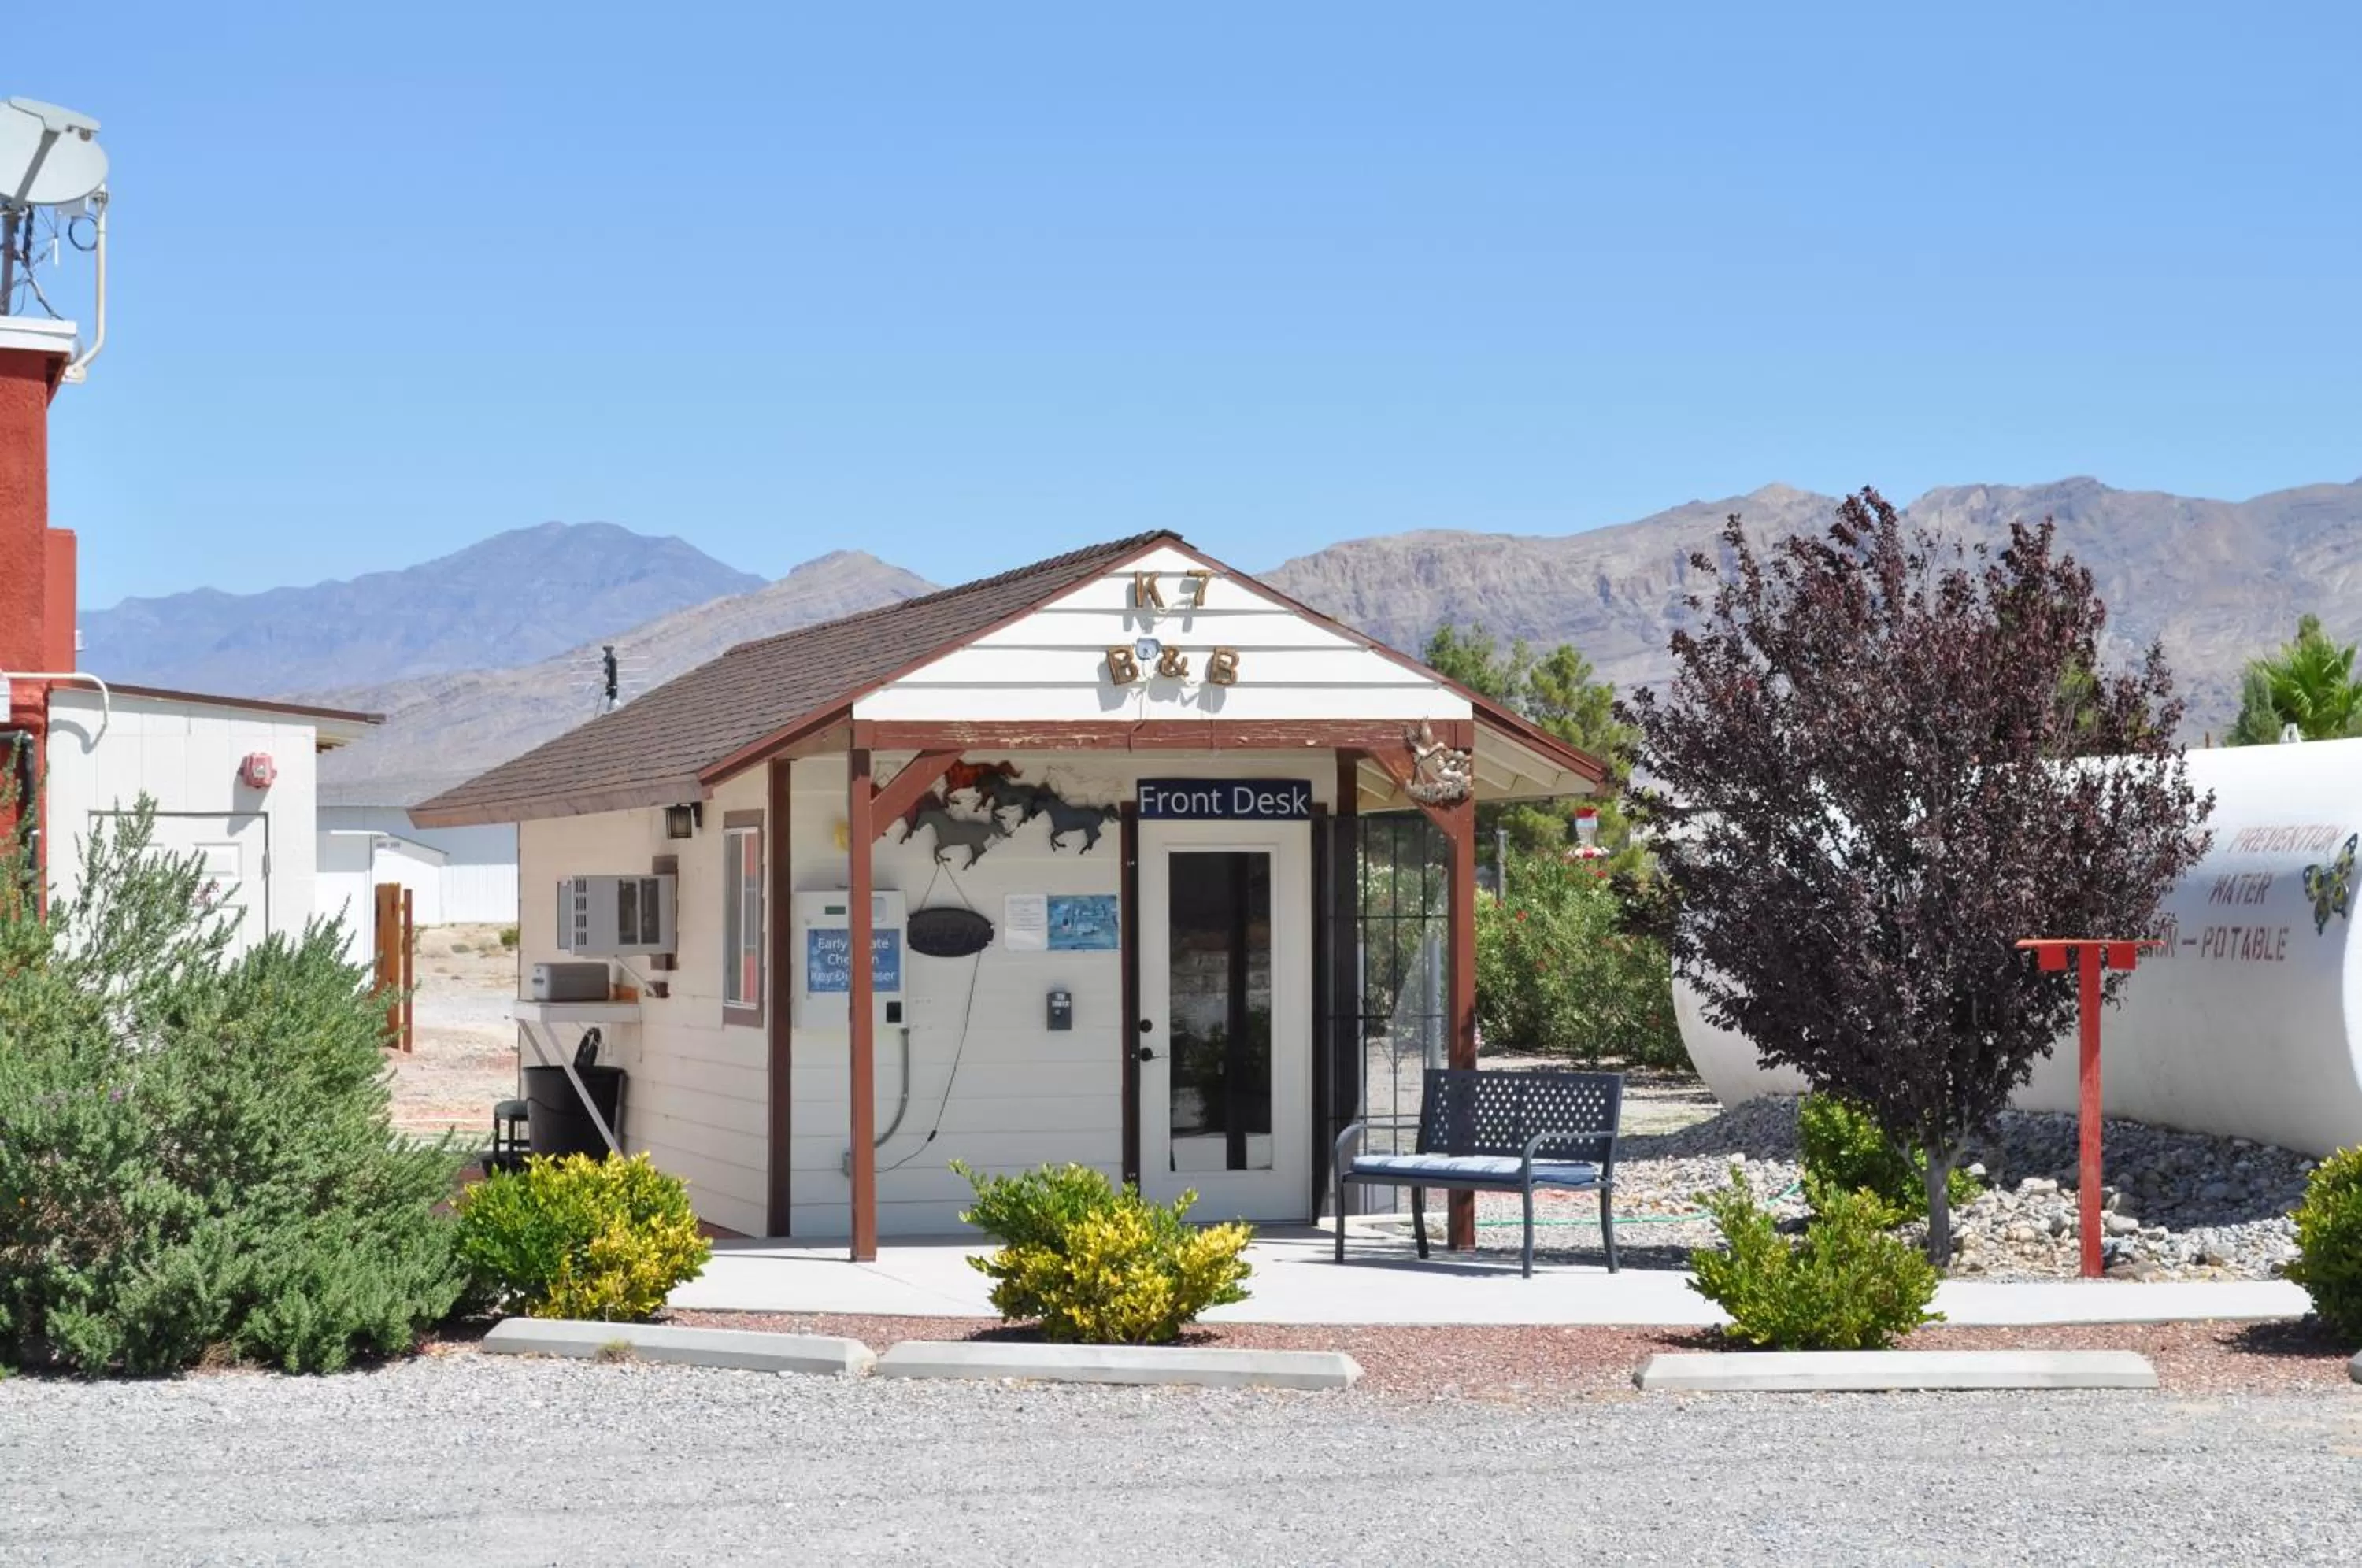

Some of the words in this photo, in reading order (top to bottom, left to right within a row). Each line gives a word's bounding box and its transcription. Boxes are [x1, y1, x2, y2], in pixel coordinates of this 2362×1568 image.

[1135, 571, 1164, 608] K
[1187, 570, 1212, 606] 7
[1107, 645, 1139, 685] B
[1159, 646, 1190, 678] &
[1209, 645, 1239, 686] B
[1139, 786, 1224, 814] Front
[1233, 786, 1309, 815] Desk
[2207, 871, 2275, 905] WATER
[818, 937, 848, 952] Early
